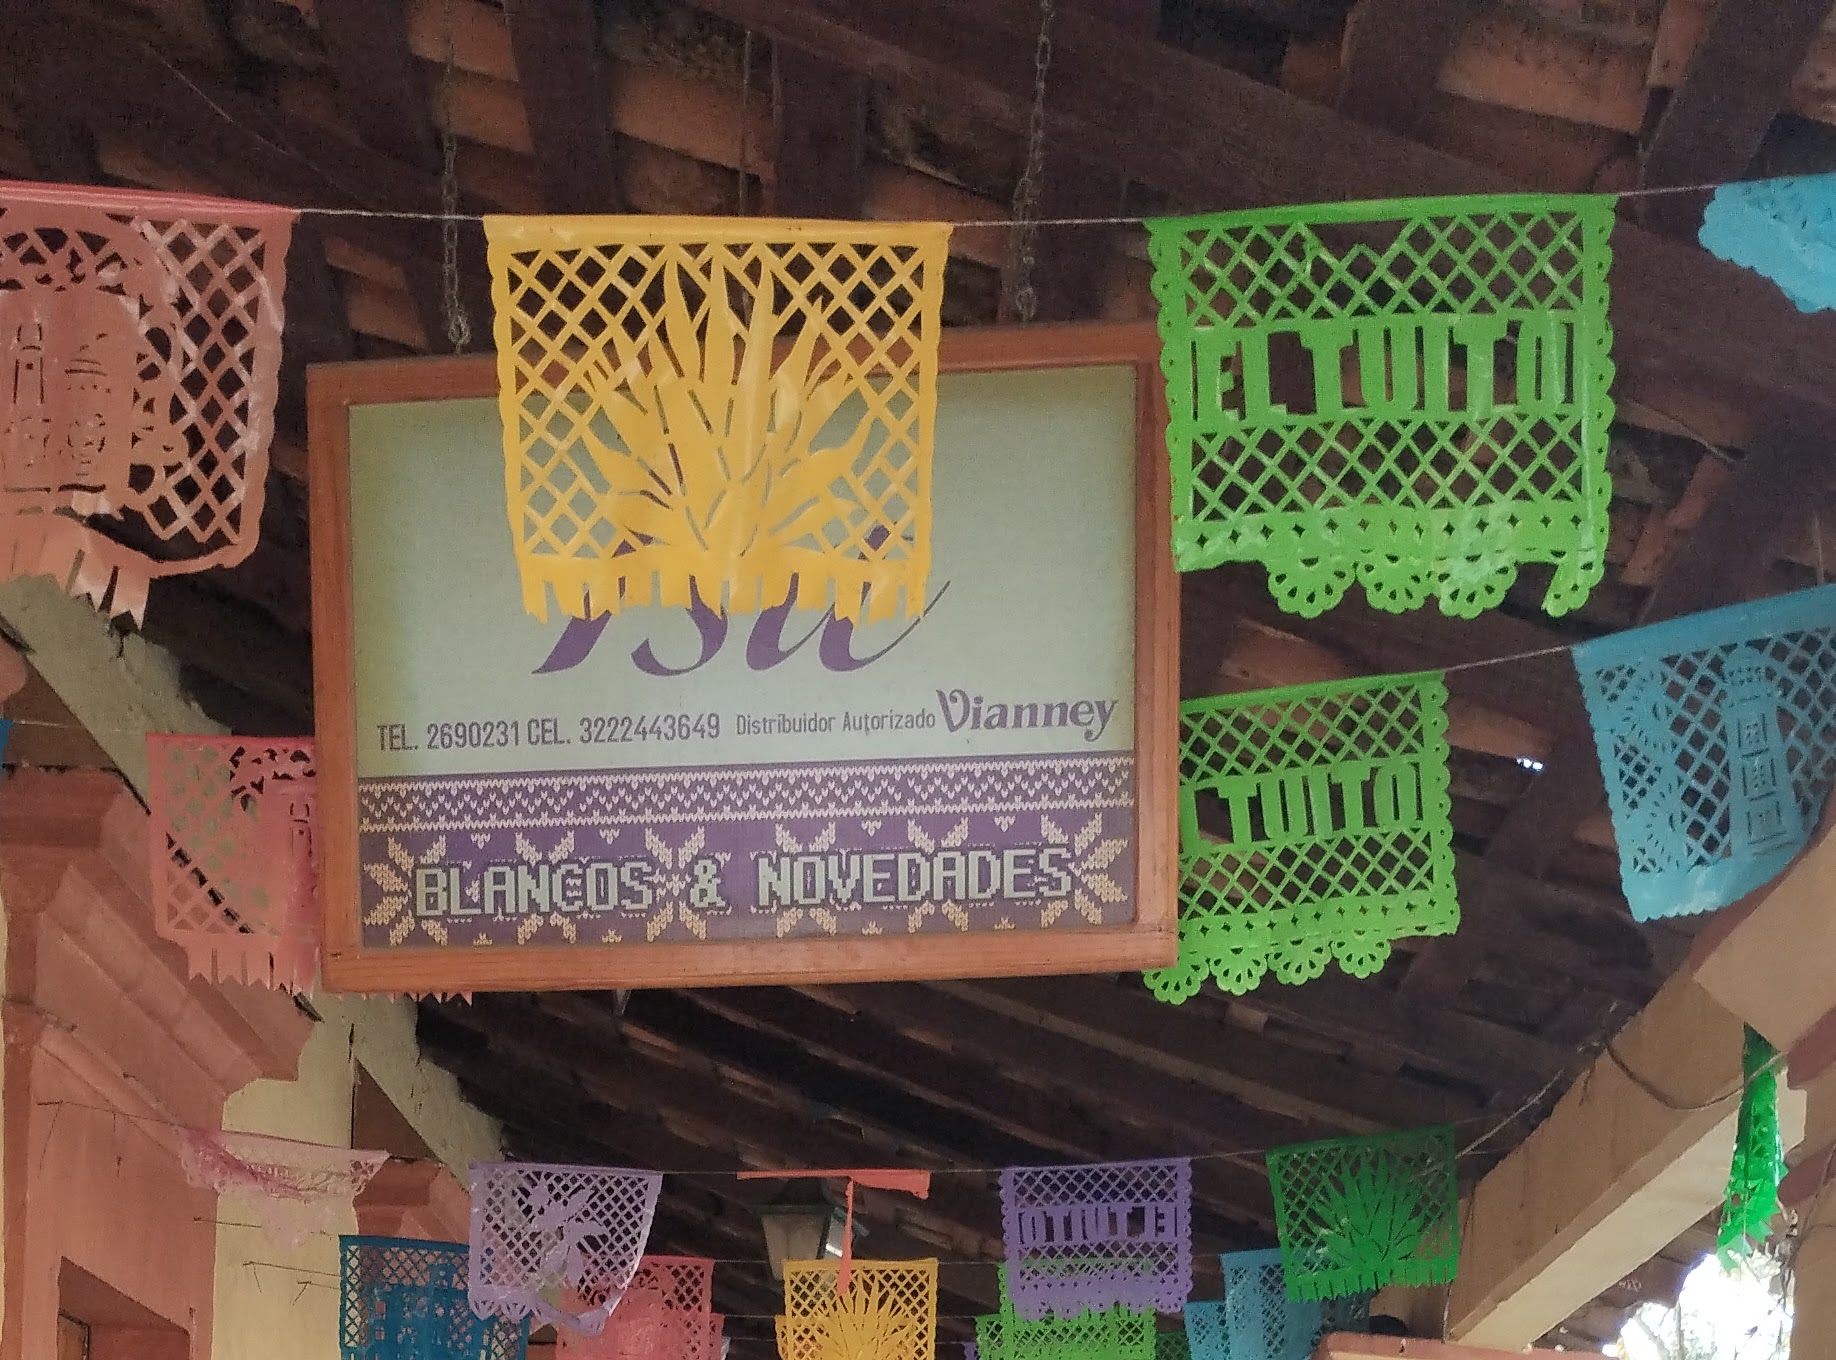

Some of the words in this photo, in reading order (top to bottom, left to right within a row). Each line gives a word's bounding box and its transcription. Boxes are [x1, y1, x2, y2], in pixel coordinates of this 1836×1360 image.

[1196, 333, 1287, 421] EL
[377, 723, 418, 751] TEL.
[426, 719, 520, 750] 2690231
[527, 717, 571, 746] CEL.
[579, 712, 721, 744] 3222443649
[736, 712, 836, 736] Distribuidor
[842, 707, 936, 736] Autorizado
[936, 688, 1119, 742] Vianney
[416, 860, 653, 917] BLANCOS
[689, 859, 726, 909] &
[757, 847, 1072, 906] NOVEDADES
